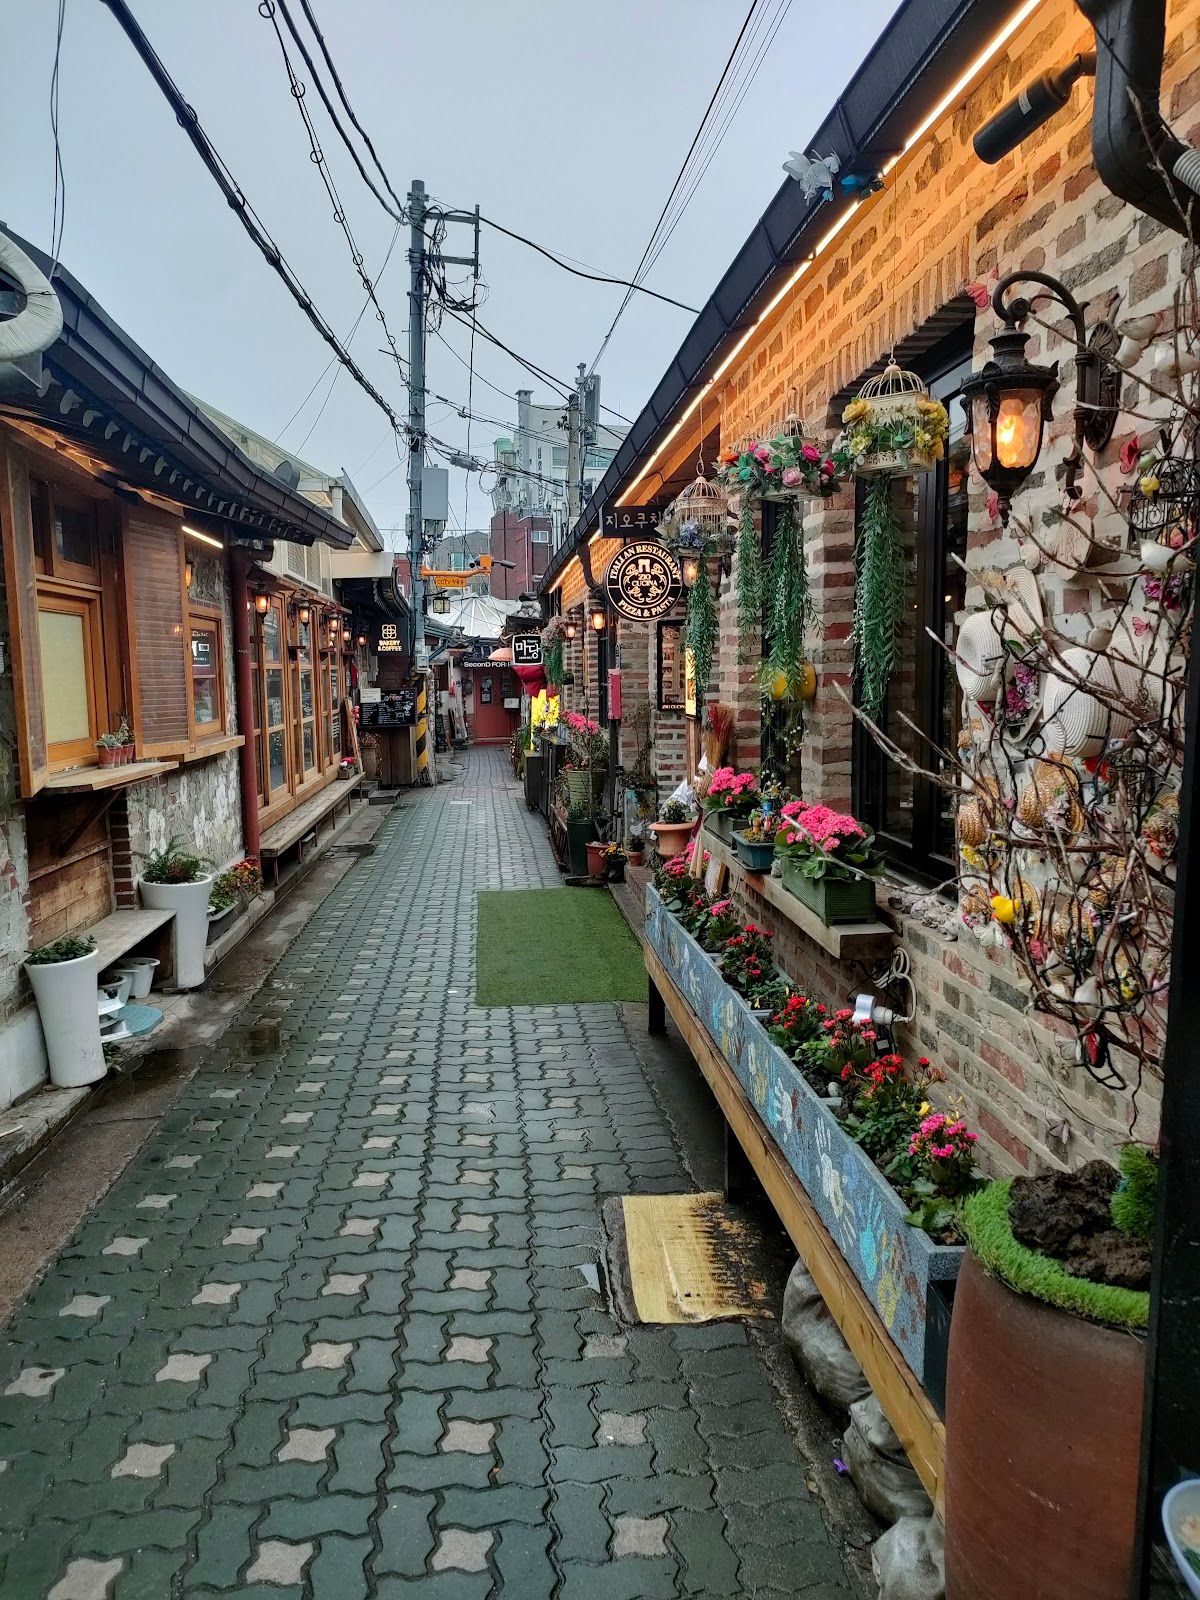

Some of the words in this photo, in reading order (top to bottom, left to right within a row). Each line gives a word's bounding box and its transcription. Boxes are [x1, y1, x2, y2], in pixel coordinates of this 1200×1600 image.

[636, 544, 681, 580] RESTAURANT
[618, 599, 642, 617] PIZZA
[643, 608, 651, 617] &
[651, 596, 676, 615] PASTA
[515, 640, 541, 659] 마당
